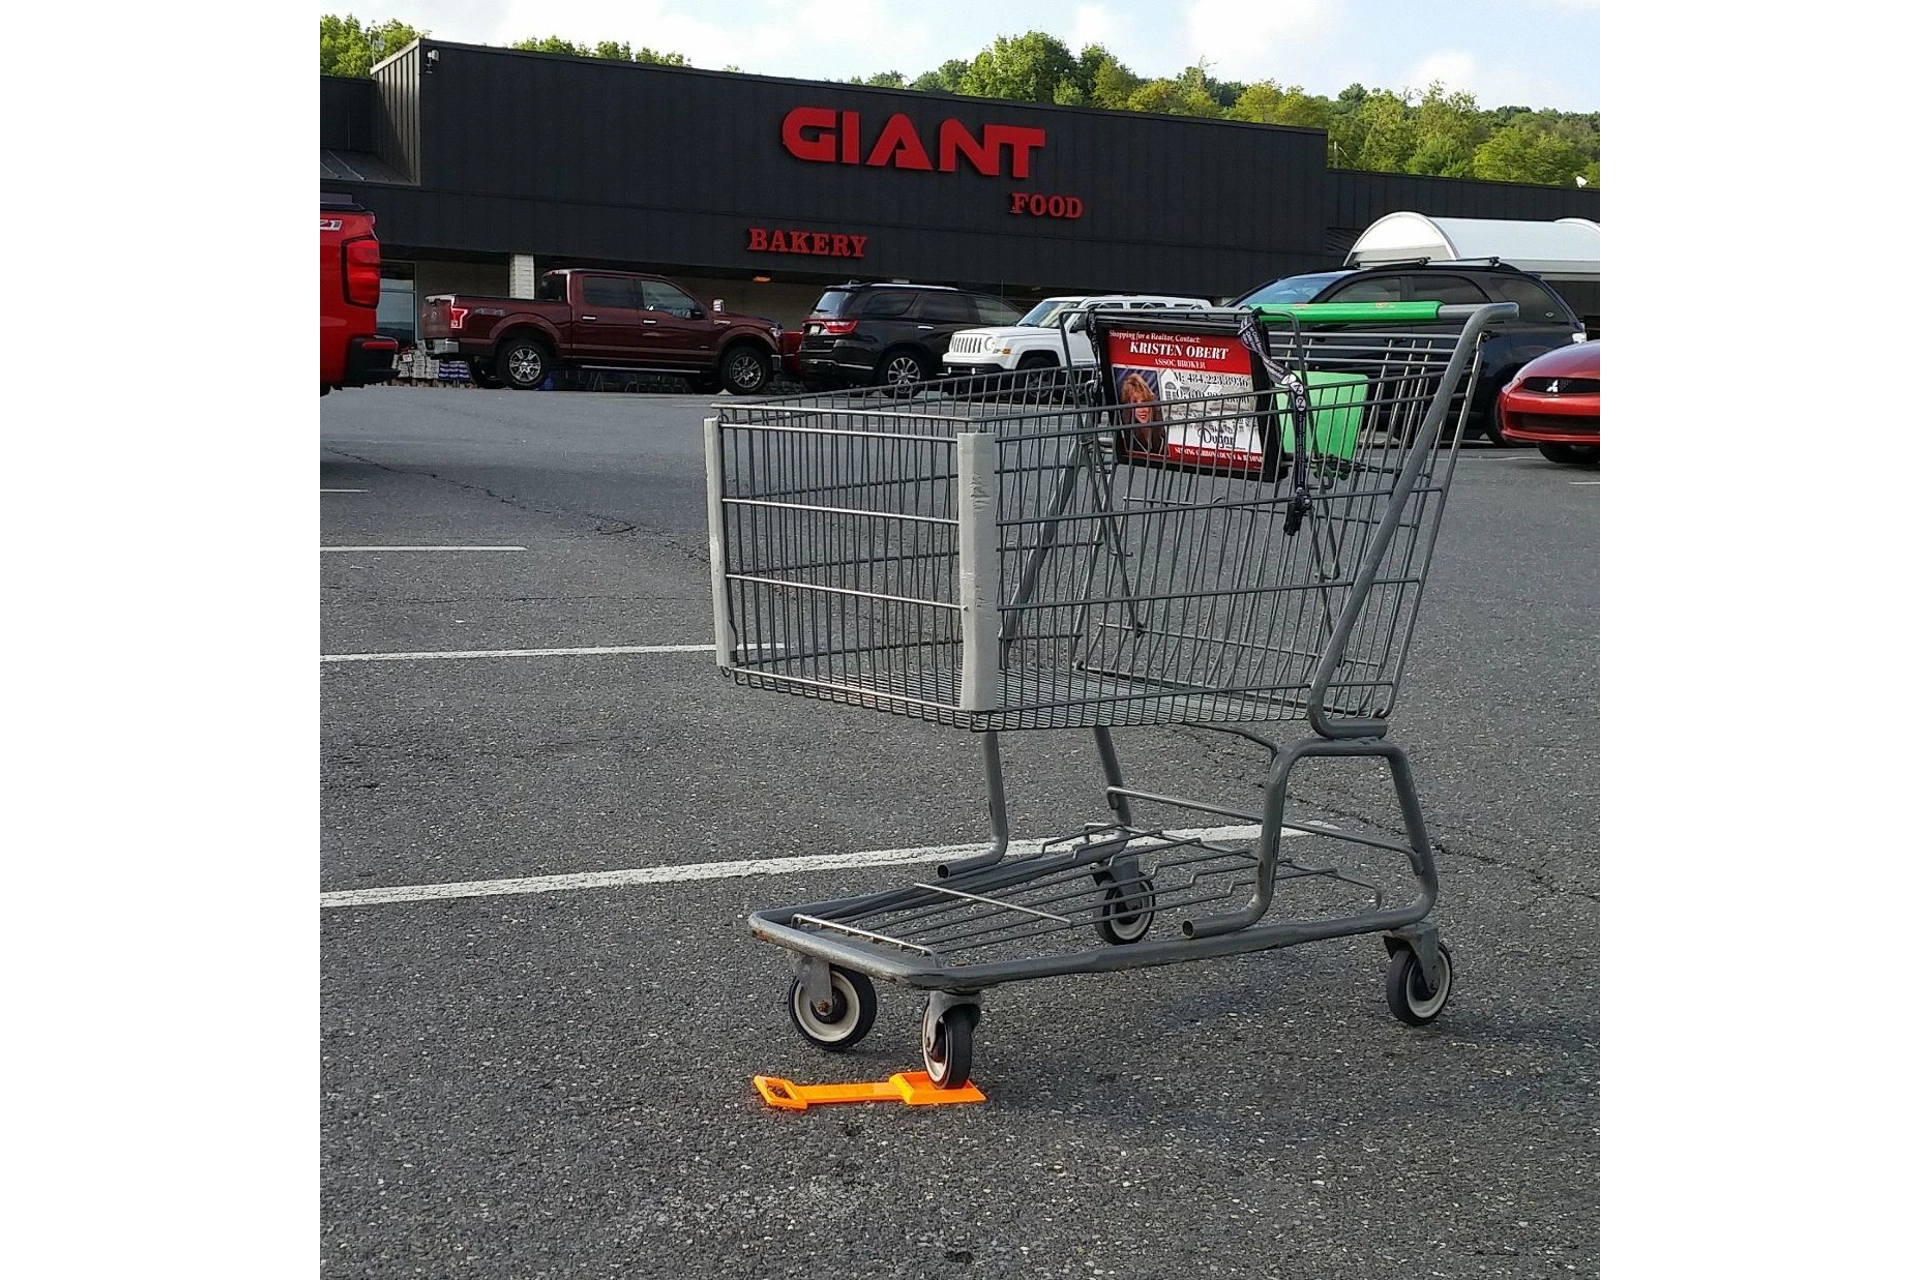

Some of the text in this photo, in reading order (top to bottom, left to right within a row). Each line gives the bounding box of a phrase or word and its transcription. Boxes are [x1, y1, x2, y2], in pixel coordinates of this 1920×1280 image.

[782, 106, 1046, 179] GIANT
[1010, 191, 1084, 219] FOOD
[747, 227, 868, 258] BAKERY
[1109, 330, 1136, 341] Shopping
[1136, 332, 1146, 340] for
[1129, 341, 1229, 360] KRISTEN OBERT
[1177, 360, 1206, 369] BROKER
